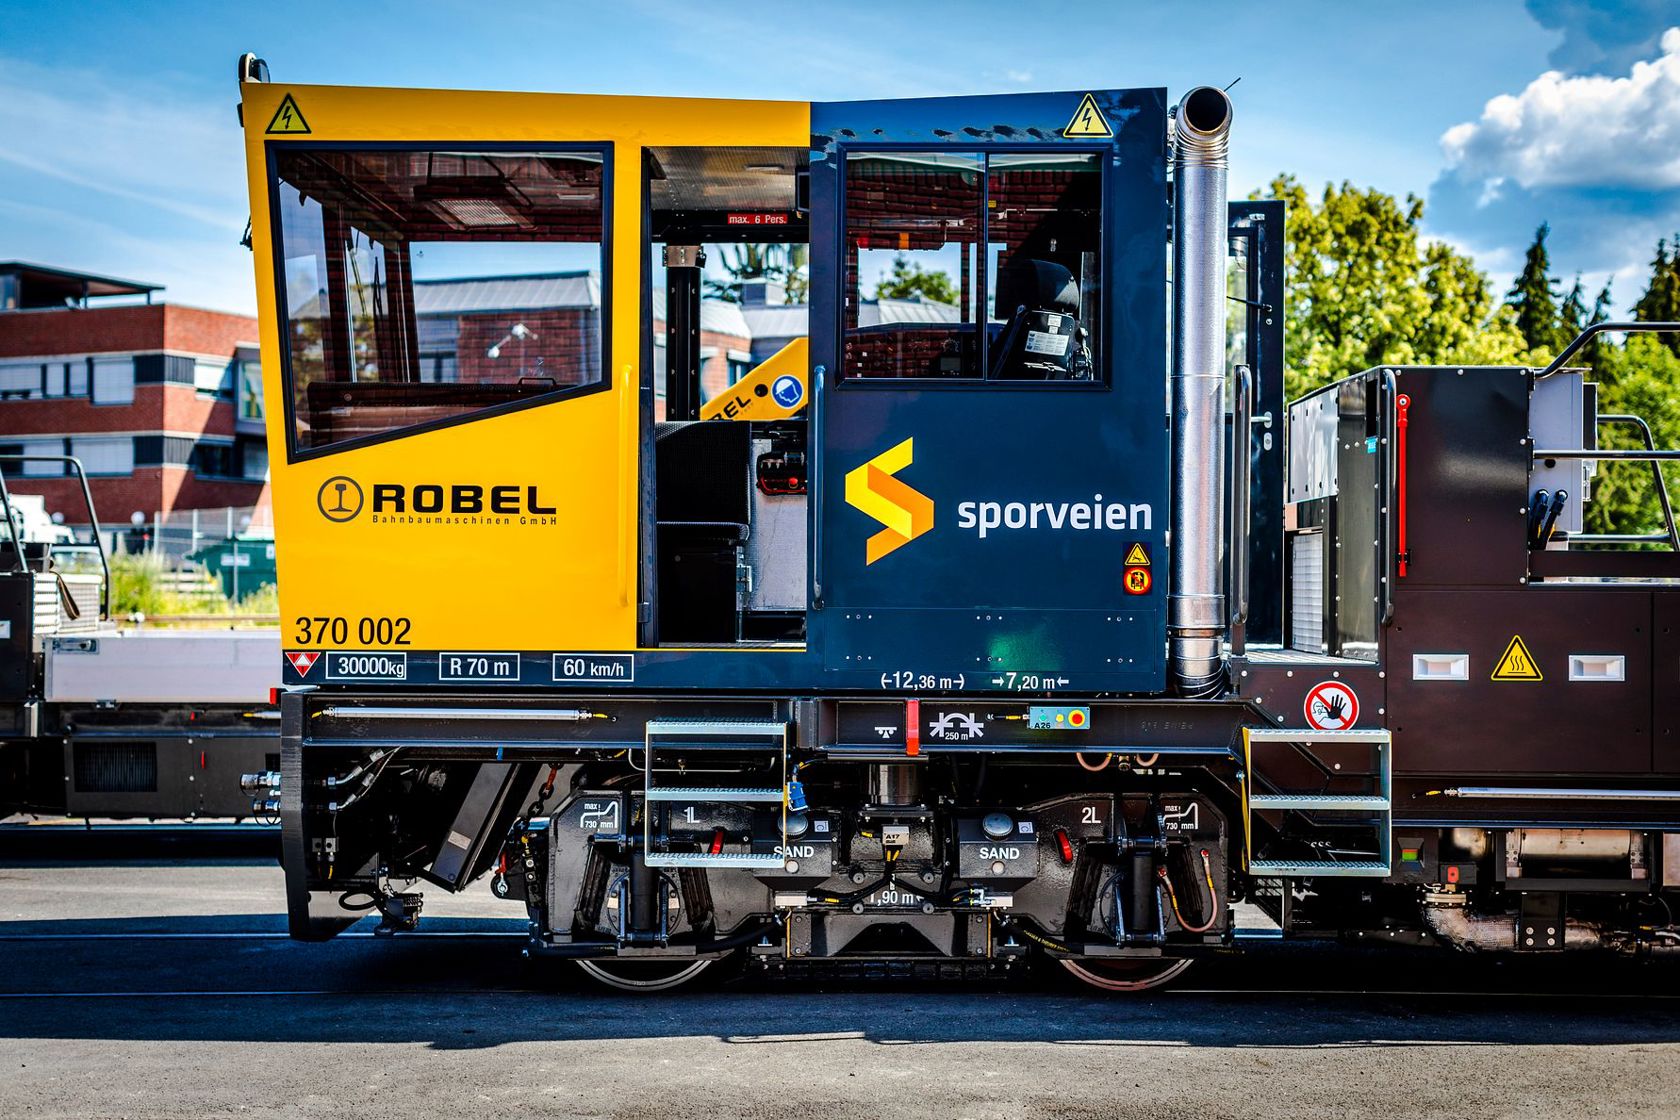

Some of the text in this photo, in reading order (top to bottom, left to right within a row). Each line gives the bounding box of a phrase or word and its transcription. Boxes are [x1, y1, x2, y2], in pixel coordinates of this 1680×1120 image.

[729, 214, 787, 224] max. 6 Pers.
[372, 484, 557, 515] ROBEL
[372, 515, 557, 526] Bahnbaumaschinen GmbH
[957, 493, 1152, 539] sporveien
[295, 616, 411, 645] 370 002
[450, 658, 510, 676] R 70 m
[563, 658, 624, 677] 60 km/h
[892, 671, 953, 691] 12,36 m
[1006, 671, 1056, 692] 7,20 m
[944, 731, 969, 741] 250 m
[584, 802, 598, 810] max
[683, 806, 701, 824] 1L
[1081, 806, 1102, 824] 2L
[585, 820, 614, 829] 730 mm
[1166, 822, 1194, 830] 730 mm
[773, 845, 815, 858] SAND
[979, 847, 1020, 860] SAND
[901, 893, 914, 904] m
